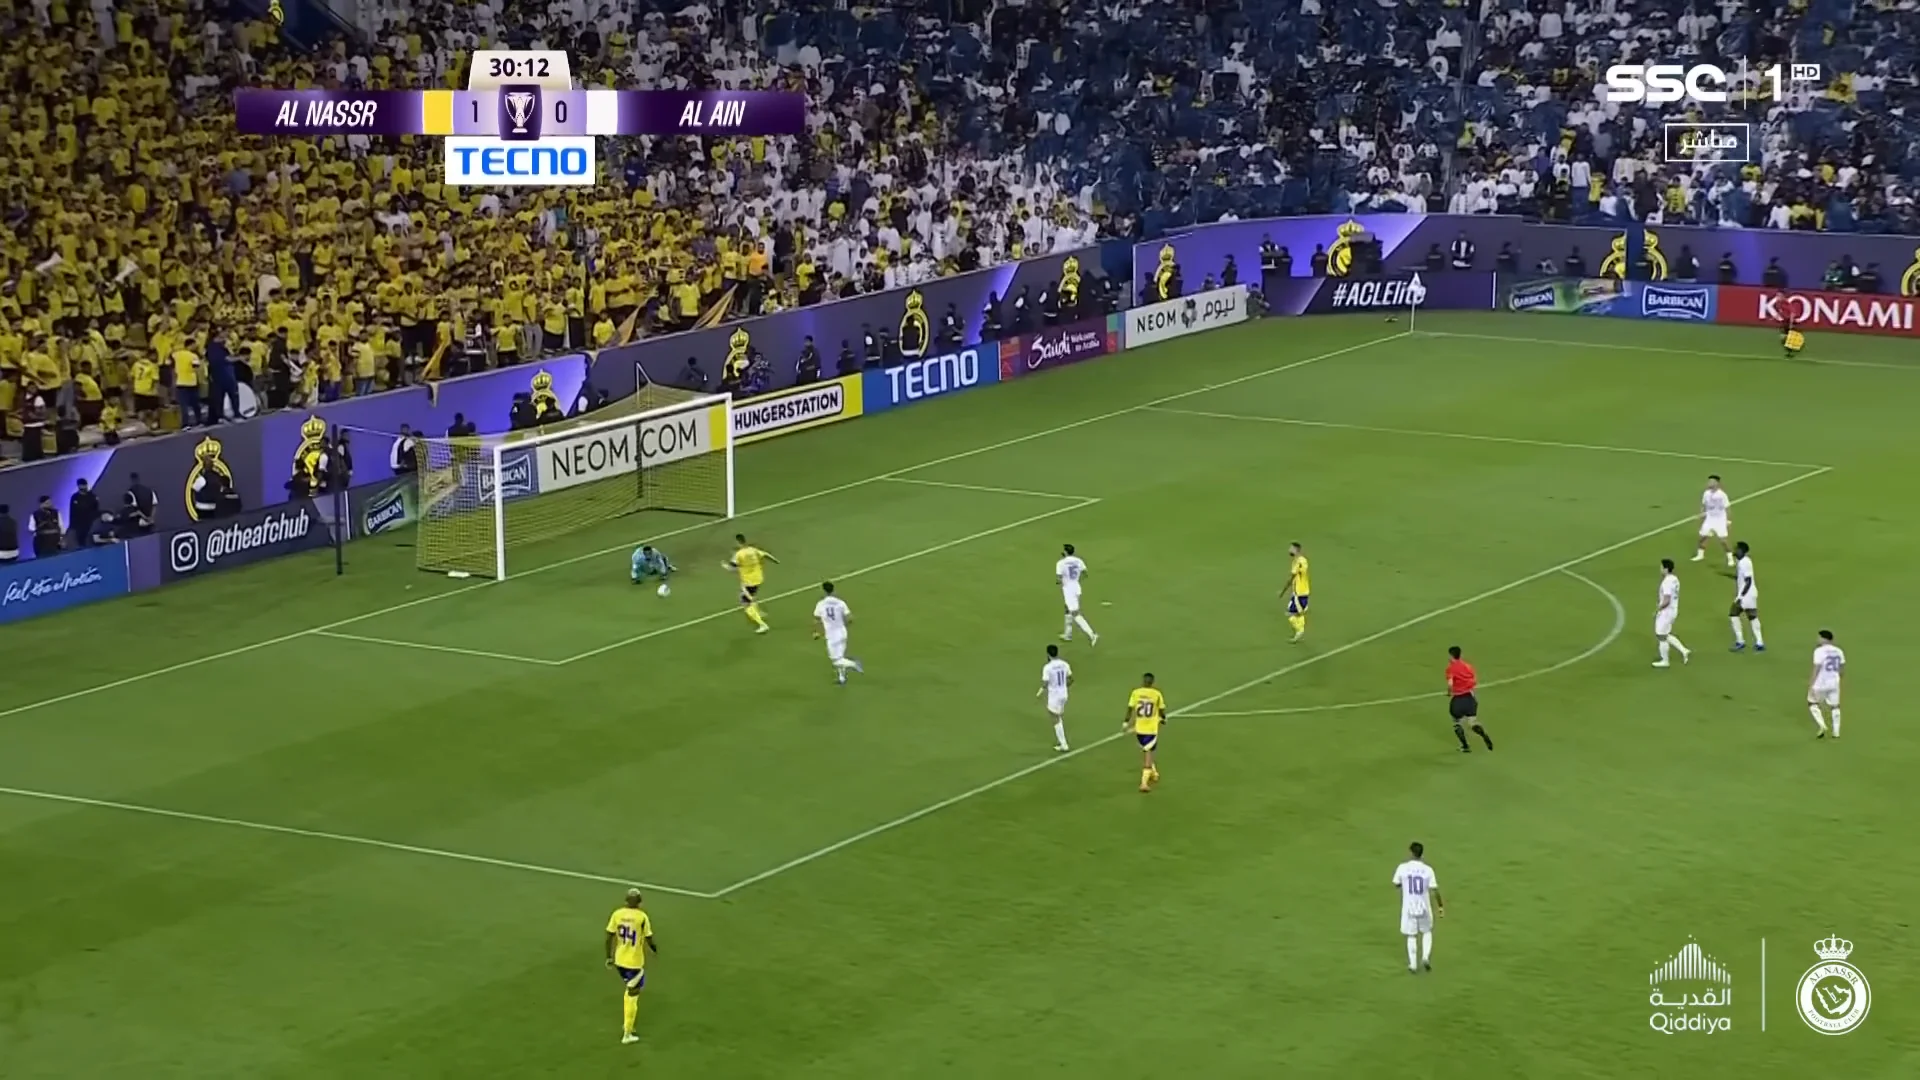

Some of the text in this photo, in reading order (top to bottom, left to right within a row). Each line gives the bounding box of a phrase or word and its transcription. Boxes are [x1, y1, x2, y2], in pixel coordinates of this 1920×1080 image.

[1202, 291, 1236, 322] نيوم
[1647, 294, 1703, 310] BARBICAN
[1758, 293, 1913, 329] KONAMI
[1136, 308, 1177, 335] NEOM
[885, 349, 979, 403] TECNO
[734, 387, 841, 431] HUNGERSTATION
[551, 417, 698, 481] NEOM.COM
[205, 508, 309, 563] @theafchub
[826, 607, 836, 621] 4
[1825, 655, 1841, 671] 20
[1056, 670, 1066, 687] 11
[1136, 700, 1154, 718] 20
[1407, 874, 1425, 896] 10
[617, 923, 637, 947] 94
